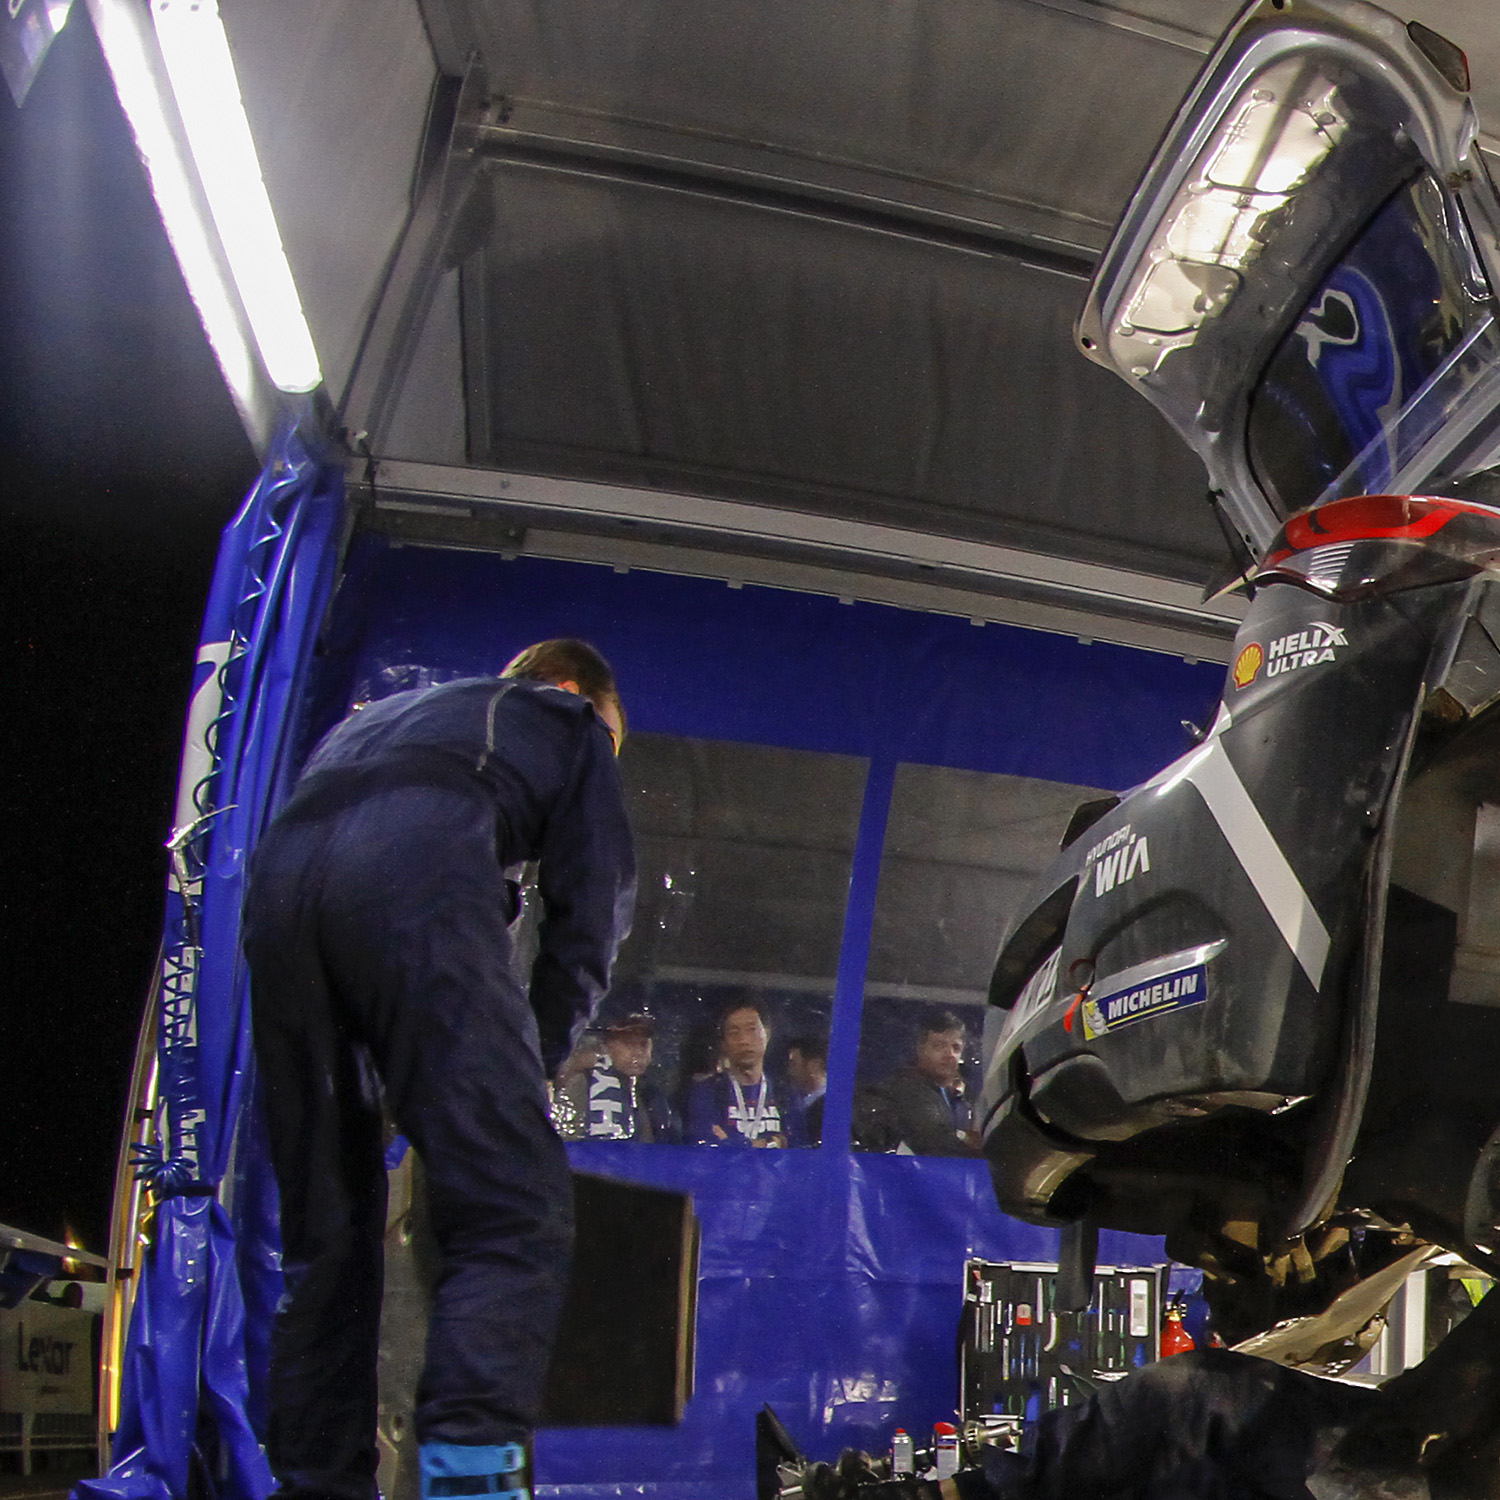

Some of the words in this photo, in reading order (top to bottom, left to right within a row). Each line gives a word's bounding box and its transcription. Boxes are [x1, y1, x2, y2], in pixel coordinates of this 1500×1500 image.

[1268, 621, 1349, 660] HELIX
[1266, 648, 1336, 677] ULTRA
[1096, 834, 1150, 898] WIA
[1108, 974, 1198, 1020] MICHELIN
